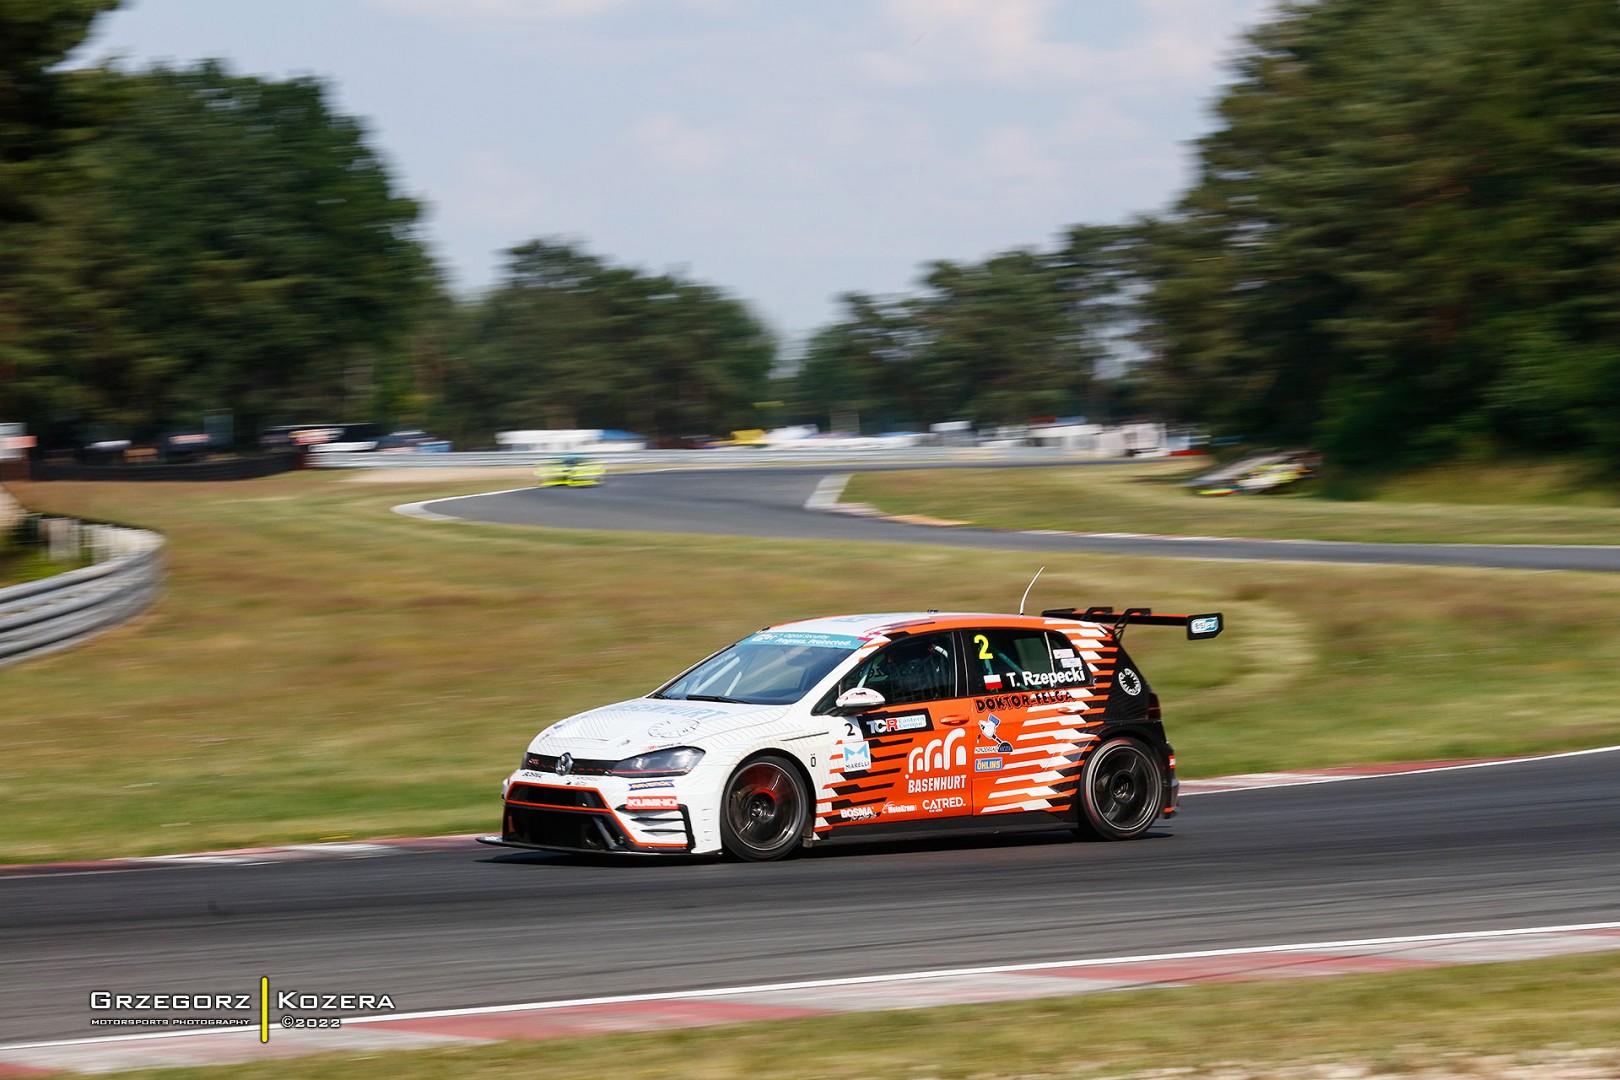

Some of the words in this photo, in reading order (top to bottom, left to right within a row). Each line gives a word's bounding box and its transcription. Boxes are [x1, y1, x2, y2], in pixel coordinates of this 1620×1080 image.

[973, 634, 994, 660] 2
[1006, 671, 1021, 688] T.
[1023, 667, 1086, 690] Rzepecki
[866, 717, 898, 734] TCR
[898, 716, 925, 724] Eastern
[898, 721, 923, 729] Europe
[844, 723, 856, 737] 2
[845, 760, 870, 770] MARELLI
[977, 759, 1001, 770] ÖHLINS
[907, 774, 967, 794] BASENHURT
[627, 798, 677, 807] KUMHO
[840, 806, 873, 820] BOSMA
